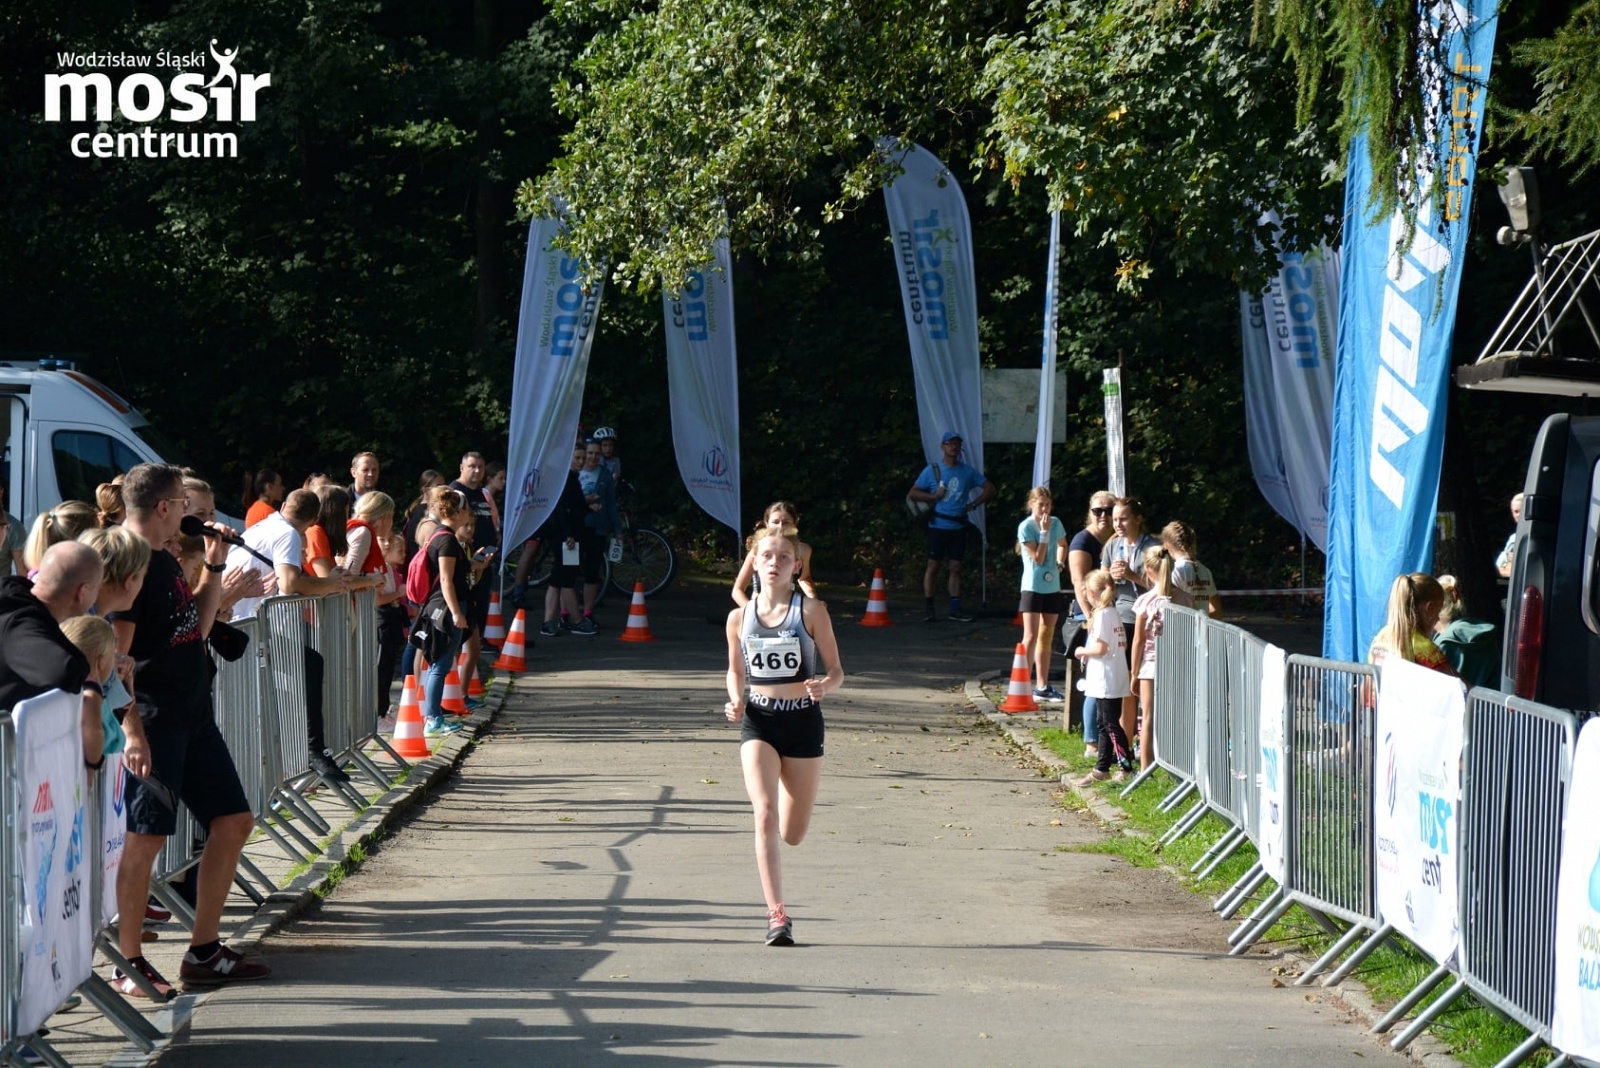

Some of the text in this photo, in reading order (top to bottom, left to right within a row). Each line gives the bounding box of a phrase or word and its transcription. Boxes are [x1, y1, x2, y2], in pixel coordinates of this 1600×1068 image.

[539, 289, 554, 348] Wodzisław
[549, 256, 583, 357] mos
[751, 651, 799, 670] 466
[773, 696, 810, 711] NIKE
